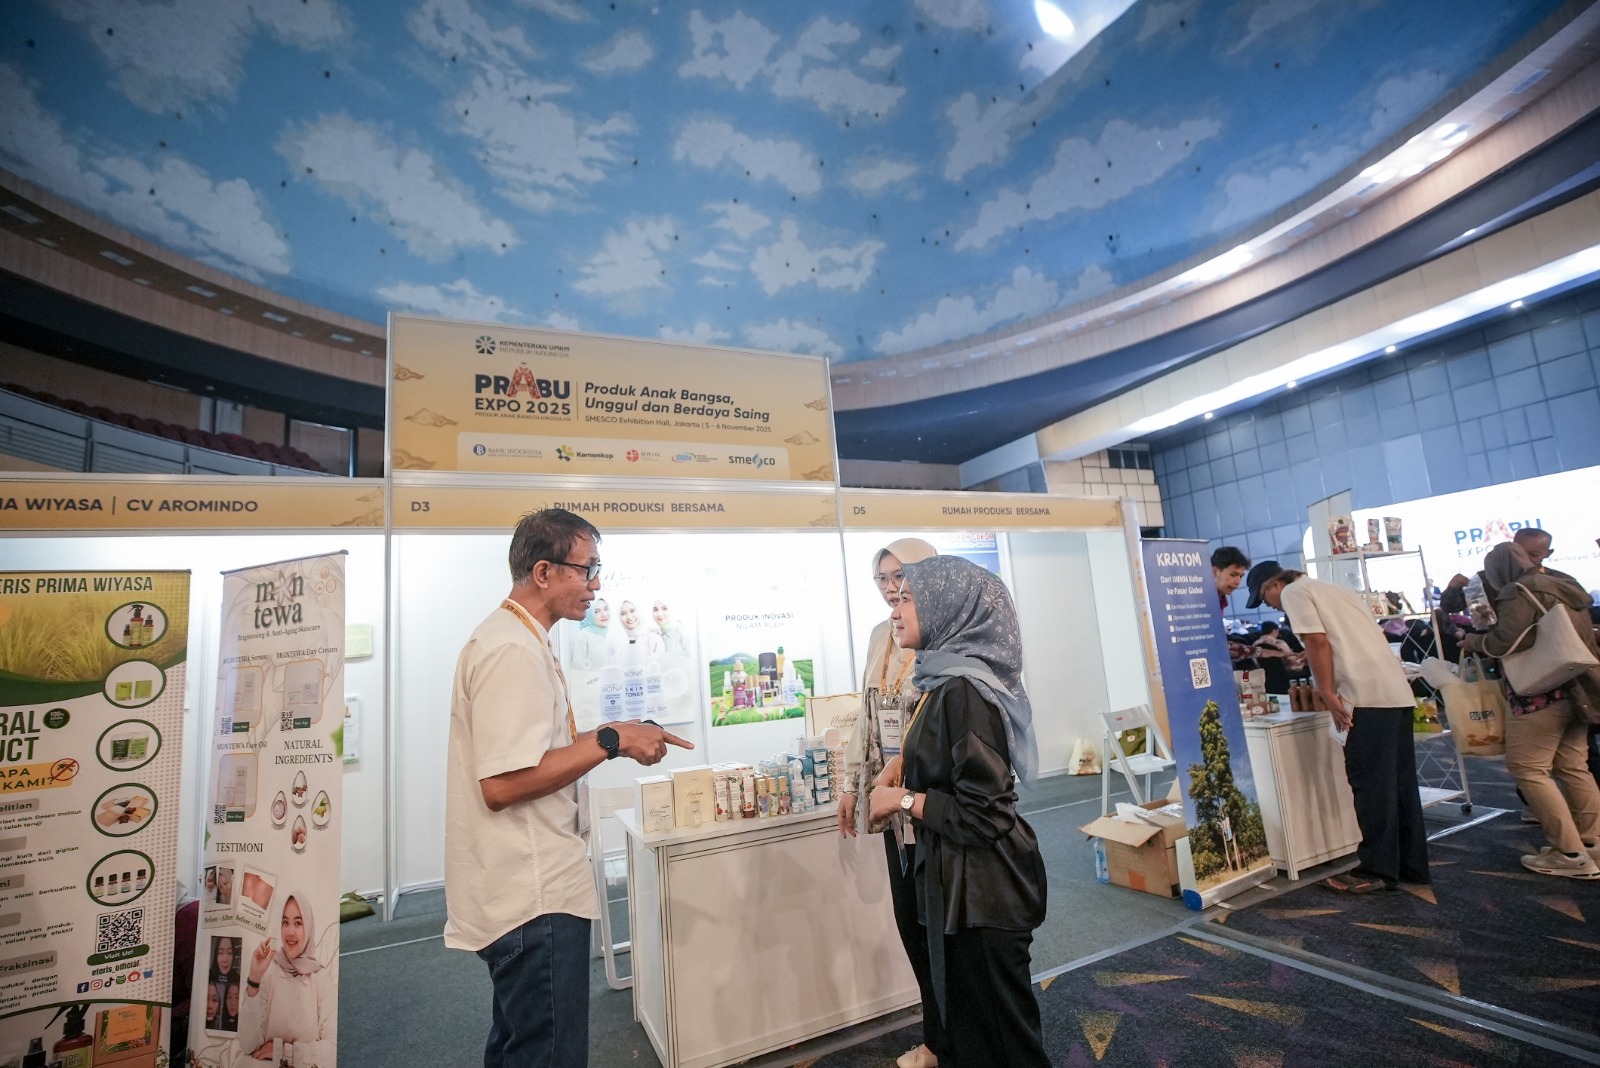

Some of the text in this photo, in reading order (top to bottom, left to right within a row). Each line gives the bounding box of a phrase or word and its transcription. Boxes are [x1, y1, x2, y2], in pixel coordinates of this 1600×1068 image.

[499, 340, 548, 350] KEMENTERIAN
[474, 366, 571, 400] PRABU
[584, 382, 735, 405] Produk Anak Bangsa,
[474, 398, 571, 415] EXPO 2025
[584, 397, 770, 422] Unggul dan Berdaya Saing
[585, 415, 618, 423] SMESCO
[619, 417, 655, 425] Exhibition
[673, 420, 700, 428] Jakarta
[755, 425, 772, 433] 2025
[25, 497, 103, 511] WIYASA
[126, 498, 153, 512] CV
[158, 499, 258, 513] AROMINDO
[411, 500, 431, 513] D3
[603, 502, 665, 512] PRODUKSI
[670, 503, 726, 513] BERSAMA
[853, 506, 866, 515] D5
[941, 506, 1051, 515] RUMAH PRODUKSI BERSAMA
[1156, 552, 1202, 567] KRATOM
[36, 577, 88, 593] PRIMA
[93, 576, 153, 592] WIYASA
[1160, 575, 1172, 584] Dari
[1188, 575, 1204, 583] Kalbar
[1166, 586, 1204, 595] ke Pasar Global
[253, 602, 304, 629] tewa
[725, 612, 794, 622] PRODUK INOVASI
[237, 632, 265, 642] Brightening
[271, 626, 298, 638] Anti-Aging
[298, 624, 321, 634] Skincare
[306, 648, 317, 658] Day
[318, 646, 338, 654] Cream
[258, 740, 268, 748] Oil
[283, 739, 324, 750] NATURAL
[275, 753, 334, 765] INGREDIENTS
[3, 777, 54, 790] KAMI?
[55, 846, 79, 855] gigitan
[215, 842, 264, 853] TESTIMONI
[14, 891, 34, 899] alami
[39, 885, 76, 895] berkualitas
[30, 933, 47, 941] yang
[104, 952, 121, 960] Visit
[31, 975, 58, 983] dengan
[32, 988, 58, 997] produk
